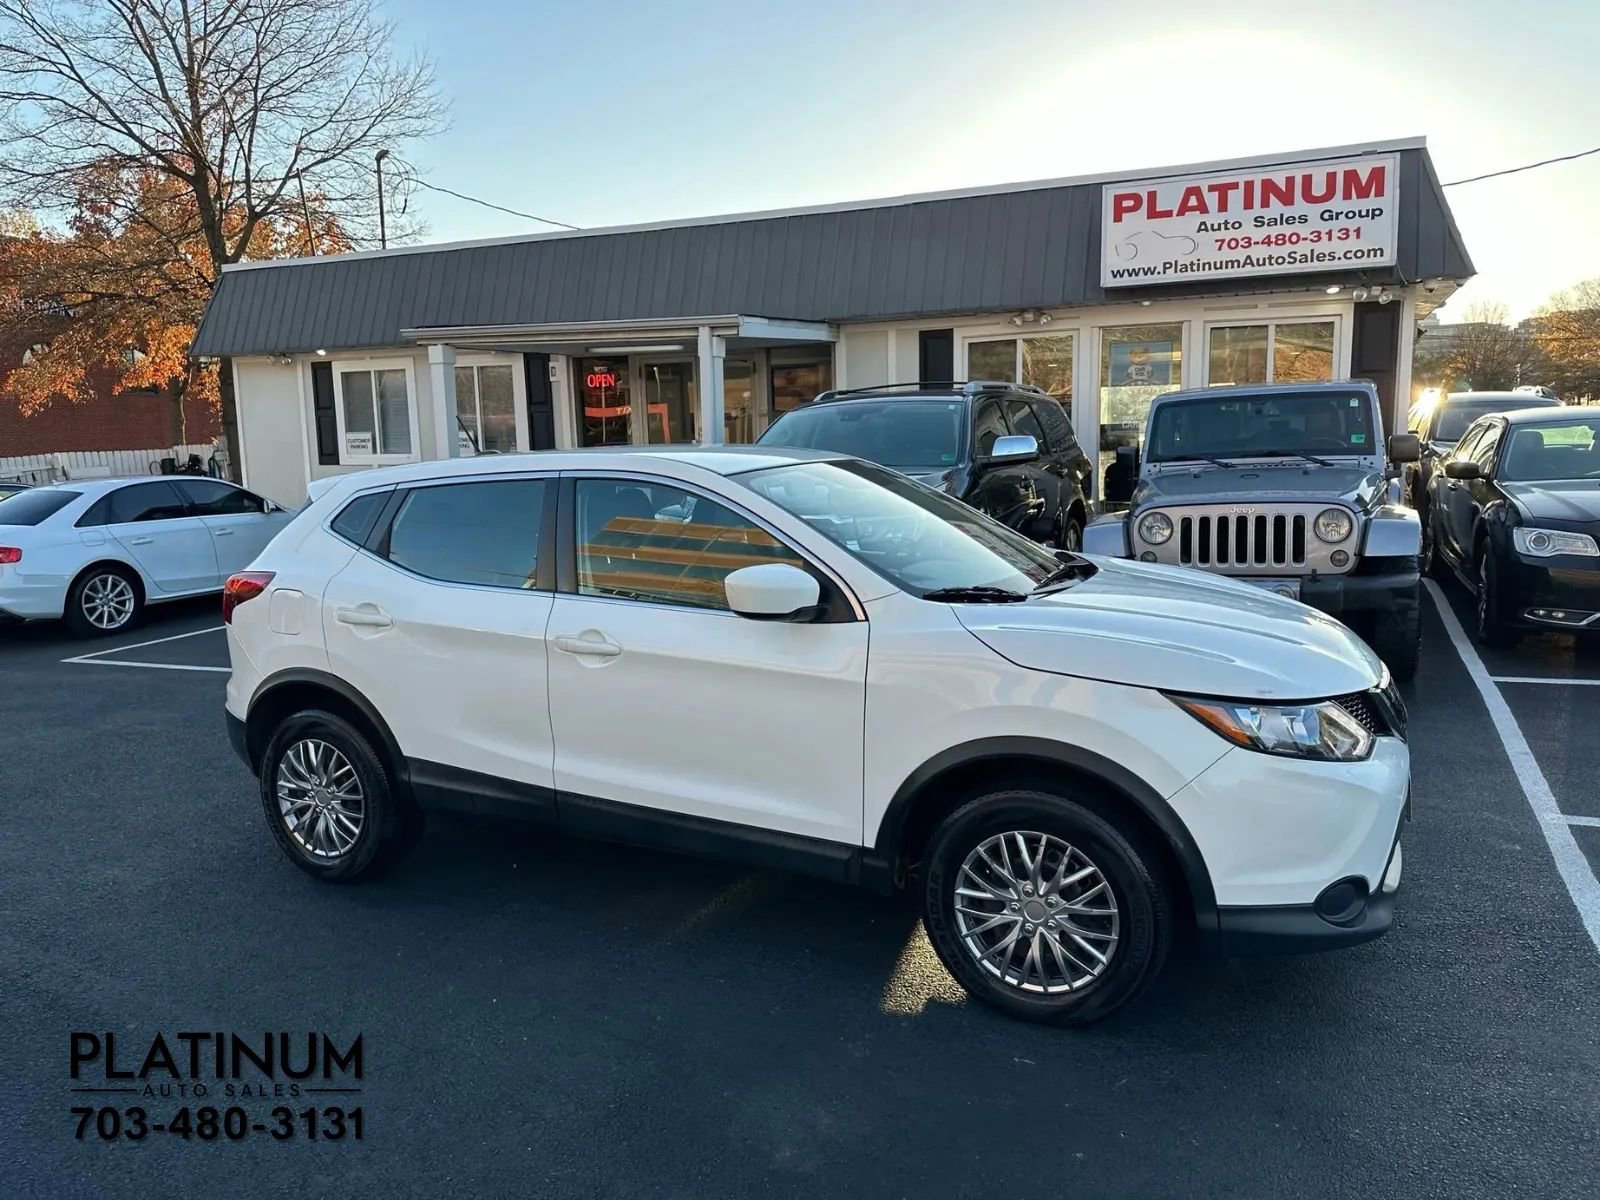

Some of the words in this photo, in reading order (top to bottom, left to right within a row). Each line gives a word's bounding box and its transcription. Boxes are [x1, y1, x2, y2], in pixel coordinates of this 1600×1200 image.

[1113, 166, 1385, 223] PLATINUM
[1196, 219, 1243, 234] Auto
[1253, 212, 1309, 229] Sales
[1319, 206, 1384, 222] Group
[1214, 226, 1362, 252] 703-480-3131
[1110, 245, 1385, 279] www.PlatinumAutoSales.com
[587, 374, 615, 388] OPEN
[1229, 506, 1255, 515] Jeep
